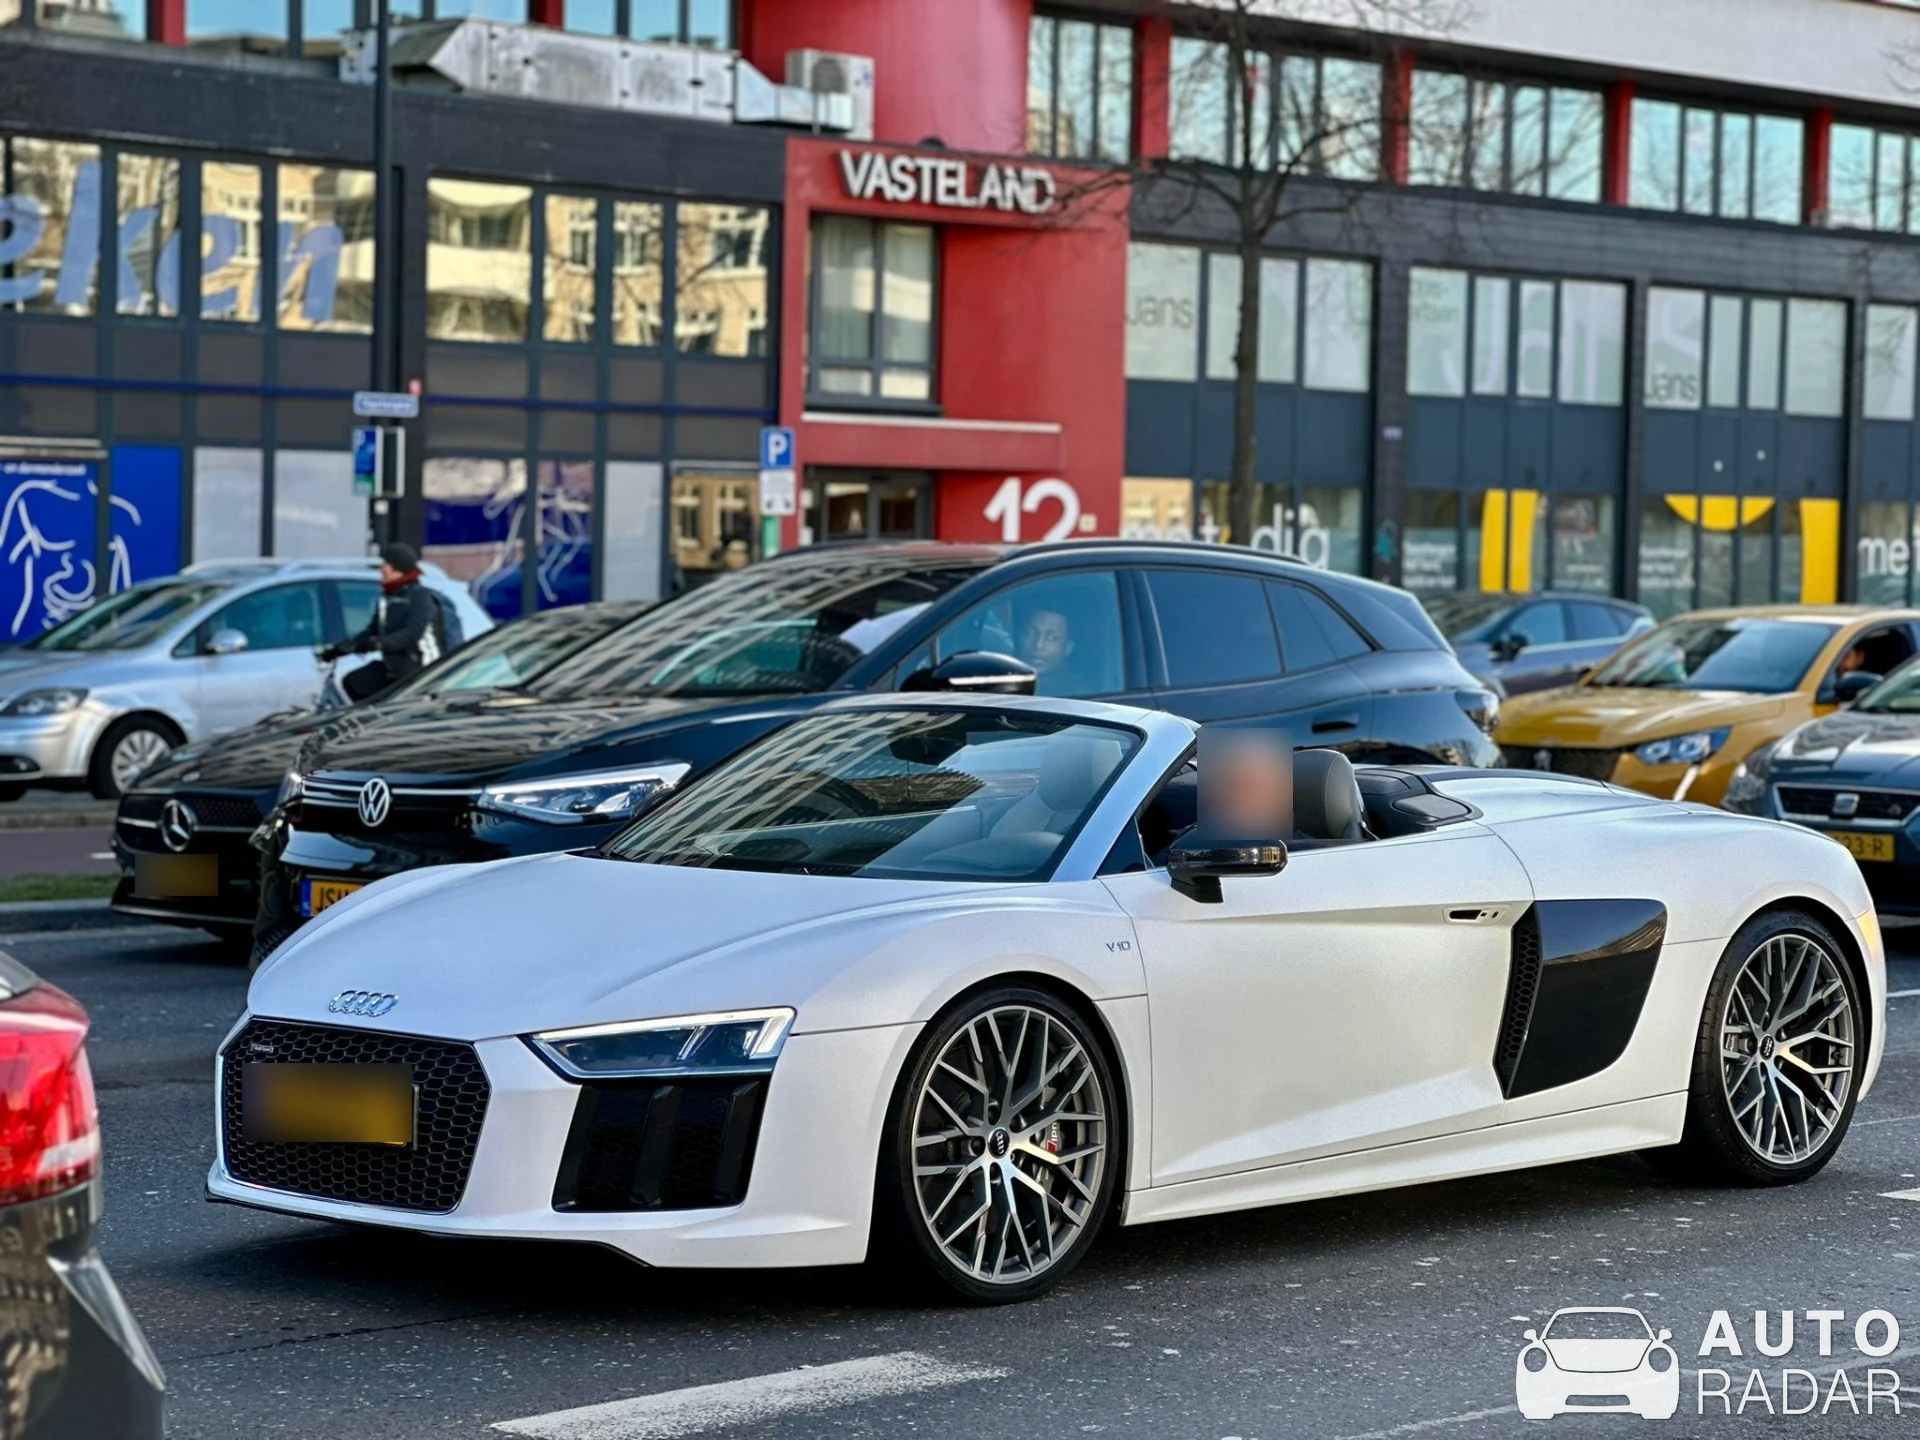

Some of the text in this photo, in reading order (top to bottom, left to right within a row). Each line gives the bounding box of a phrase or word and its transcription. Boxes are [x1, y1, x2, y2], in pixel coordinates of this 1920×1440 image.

[840, 150, 1056, 213] VASTELAND
[1123, 294, 1194, 330] Jans
[1644, 371, 1699, 402] Jans
[768, 432, 788, 465] P
[983, 476, 1081, 544] 12
[1105, 940, 1131, 952] V10
